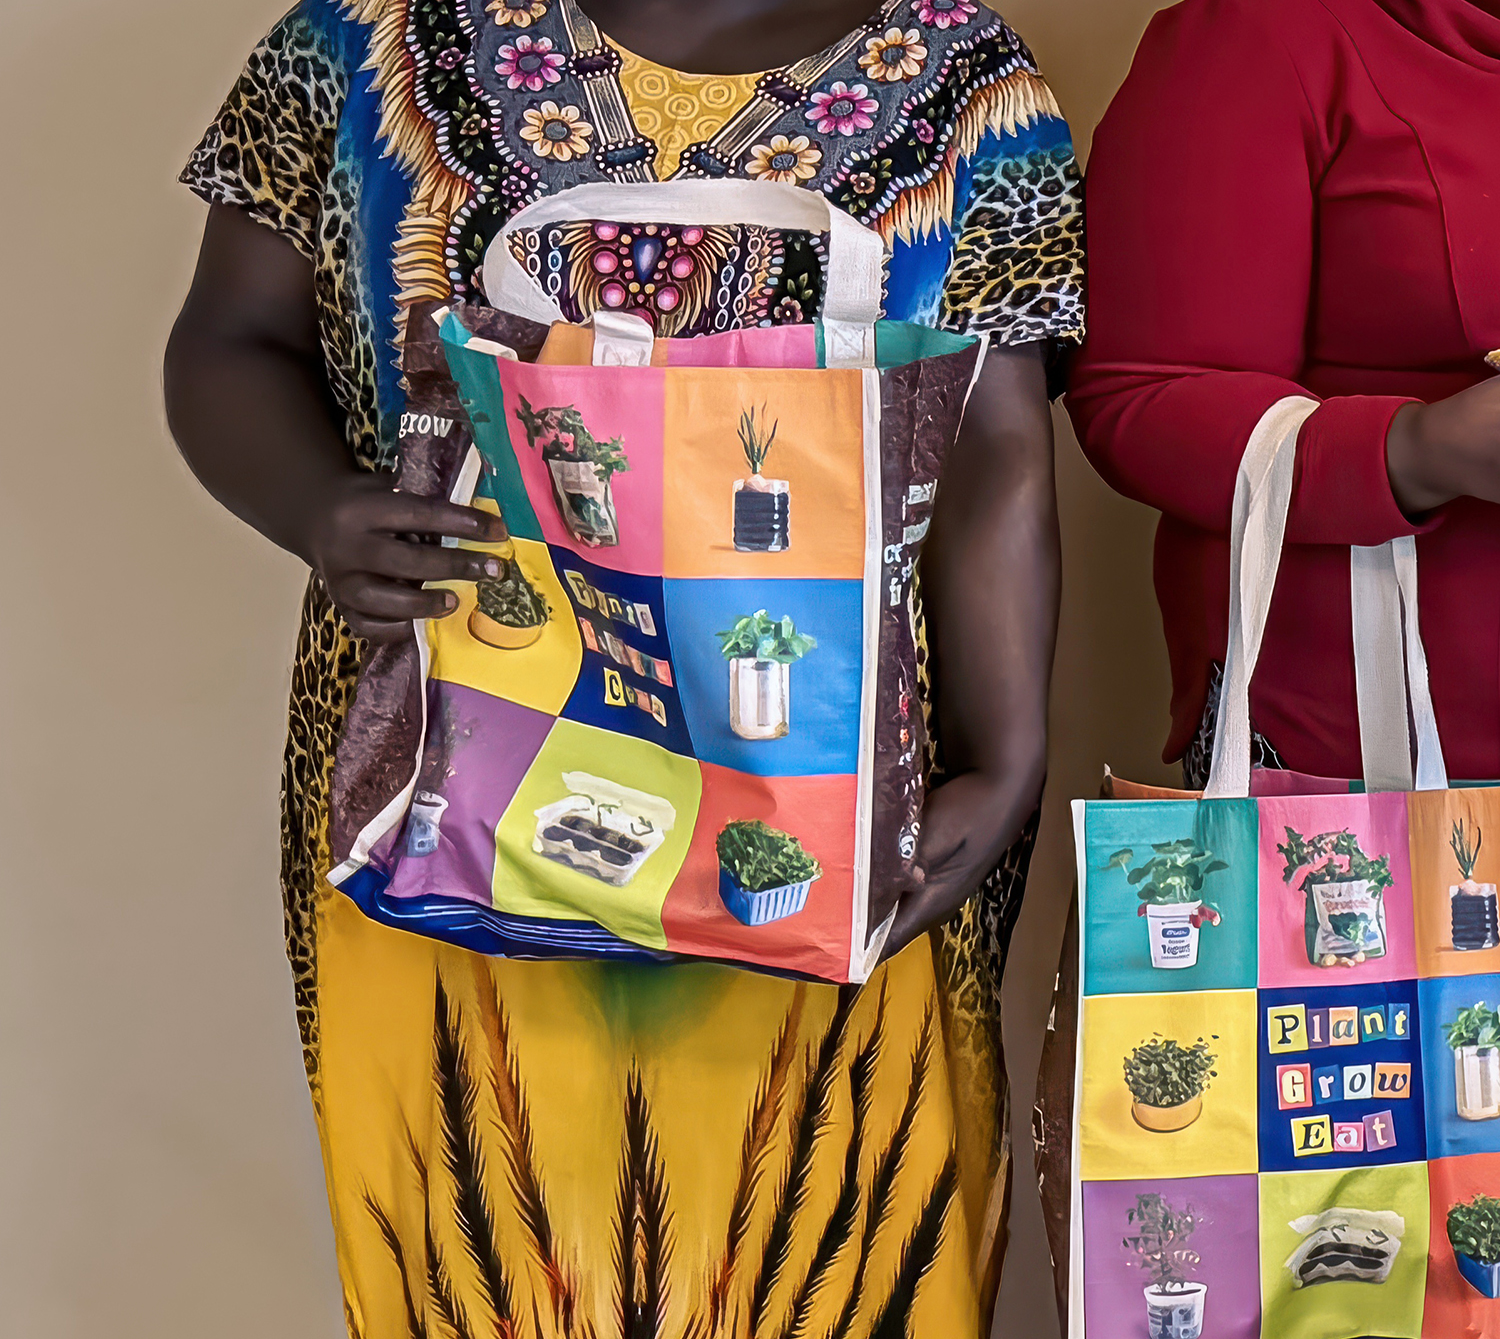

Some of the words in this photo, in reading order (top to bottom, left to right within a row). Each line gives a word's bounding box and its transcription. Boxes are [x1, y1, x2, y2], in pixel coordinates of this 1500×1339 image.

[1274, 1010, 1407, 1044] Plant
[1281, 1070, 1407, 1104] Grow
[1298, 1117, 1388, 1150] Eat
